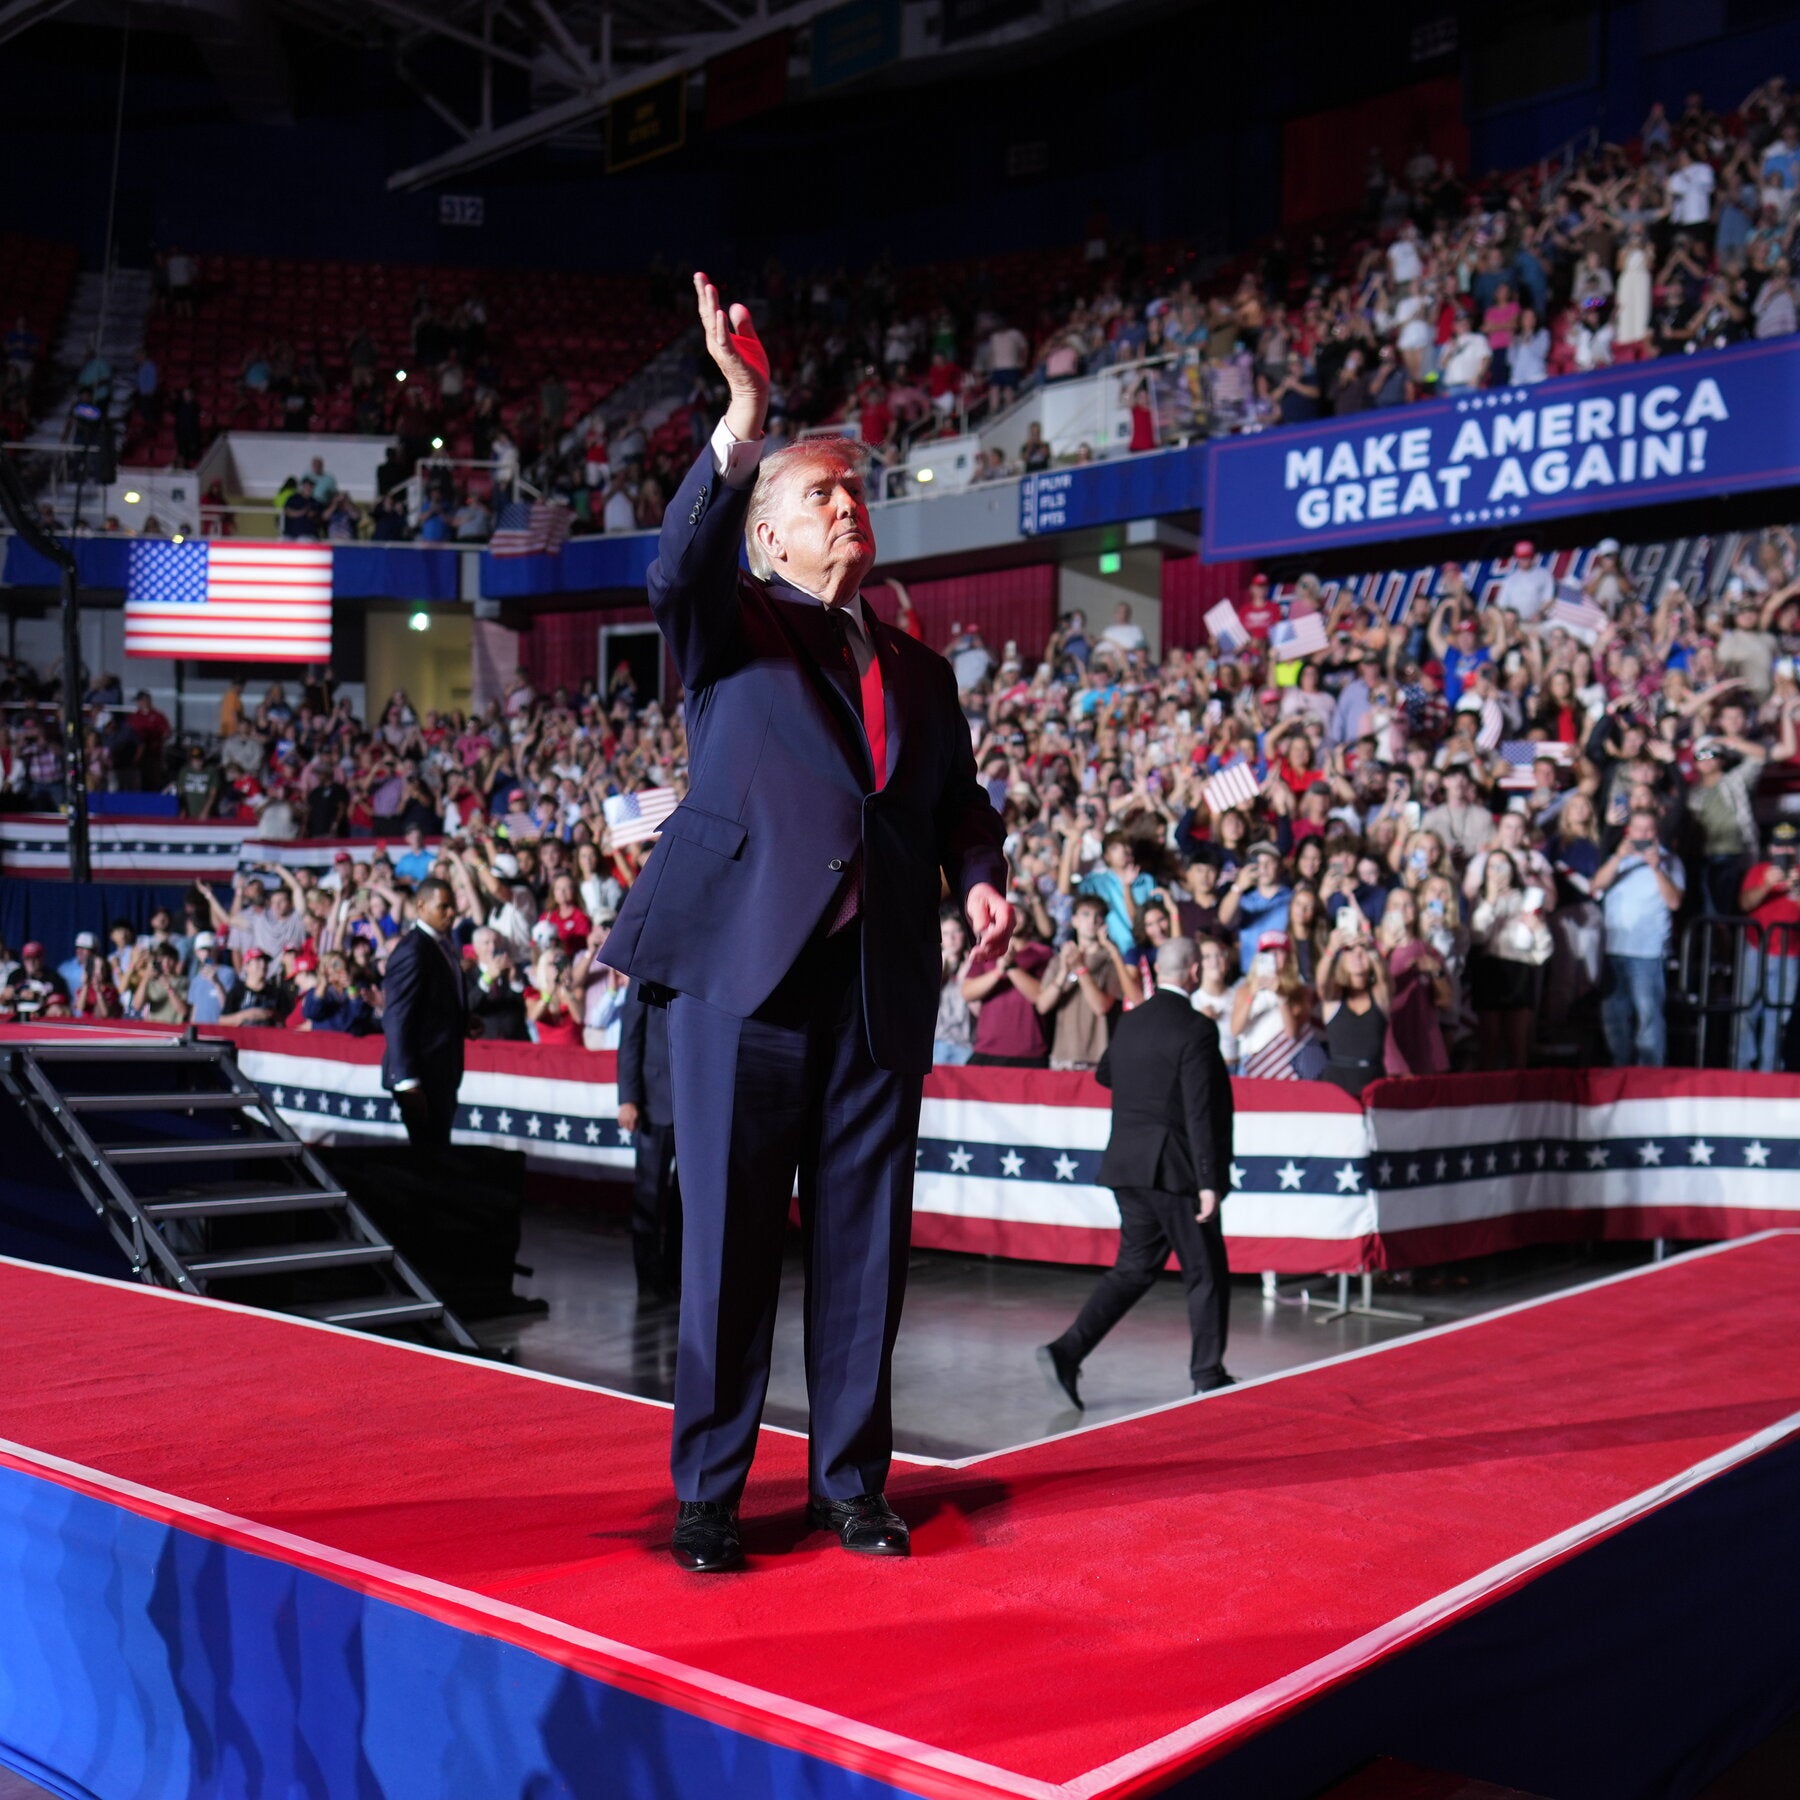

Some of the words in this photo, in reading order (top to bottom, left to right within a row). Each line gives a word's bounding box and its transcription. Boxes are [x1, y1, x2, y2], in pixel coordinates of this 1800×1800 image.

[1285, 427, 1432, 489] MAKE
[1449, 379, 1729, 463] AMERICA
[1296, 464, 1472, 530] GREAT
[1488, 428, 1708, 502] AGAIN!
